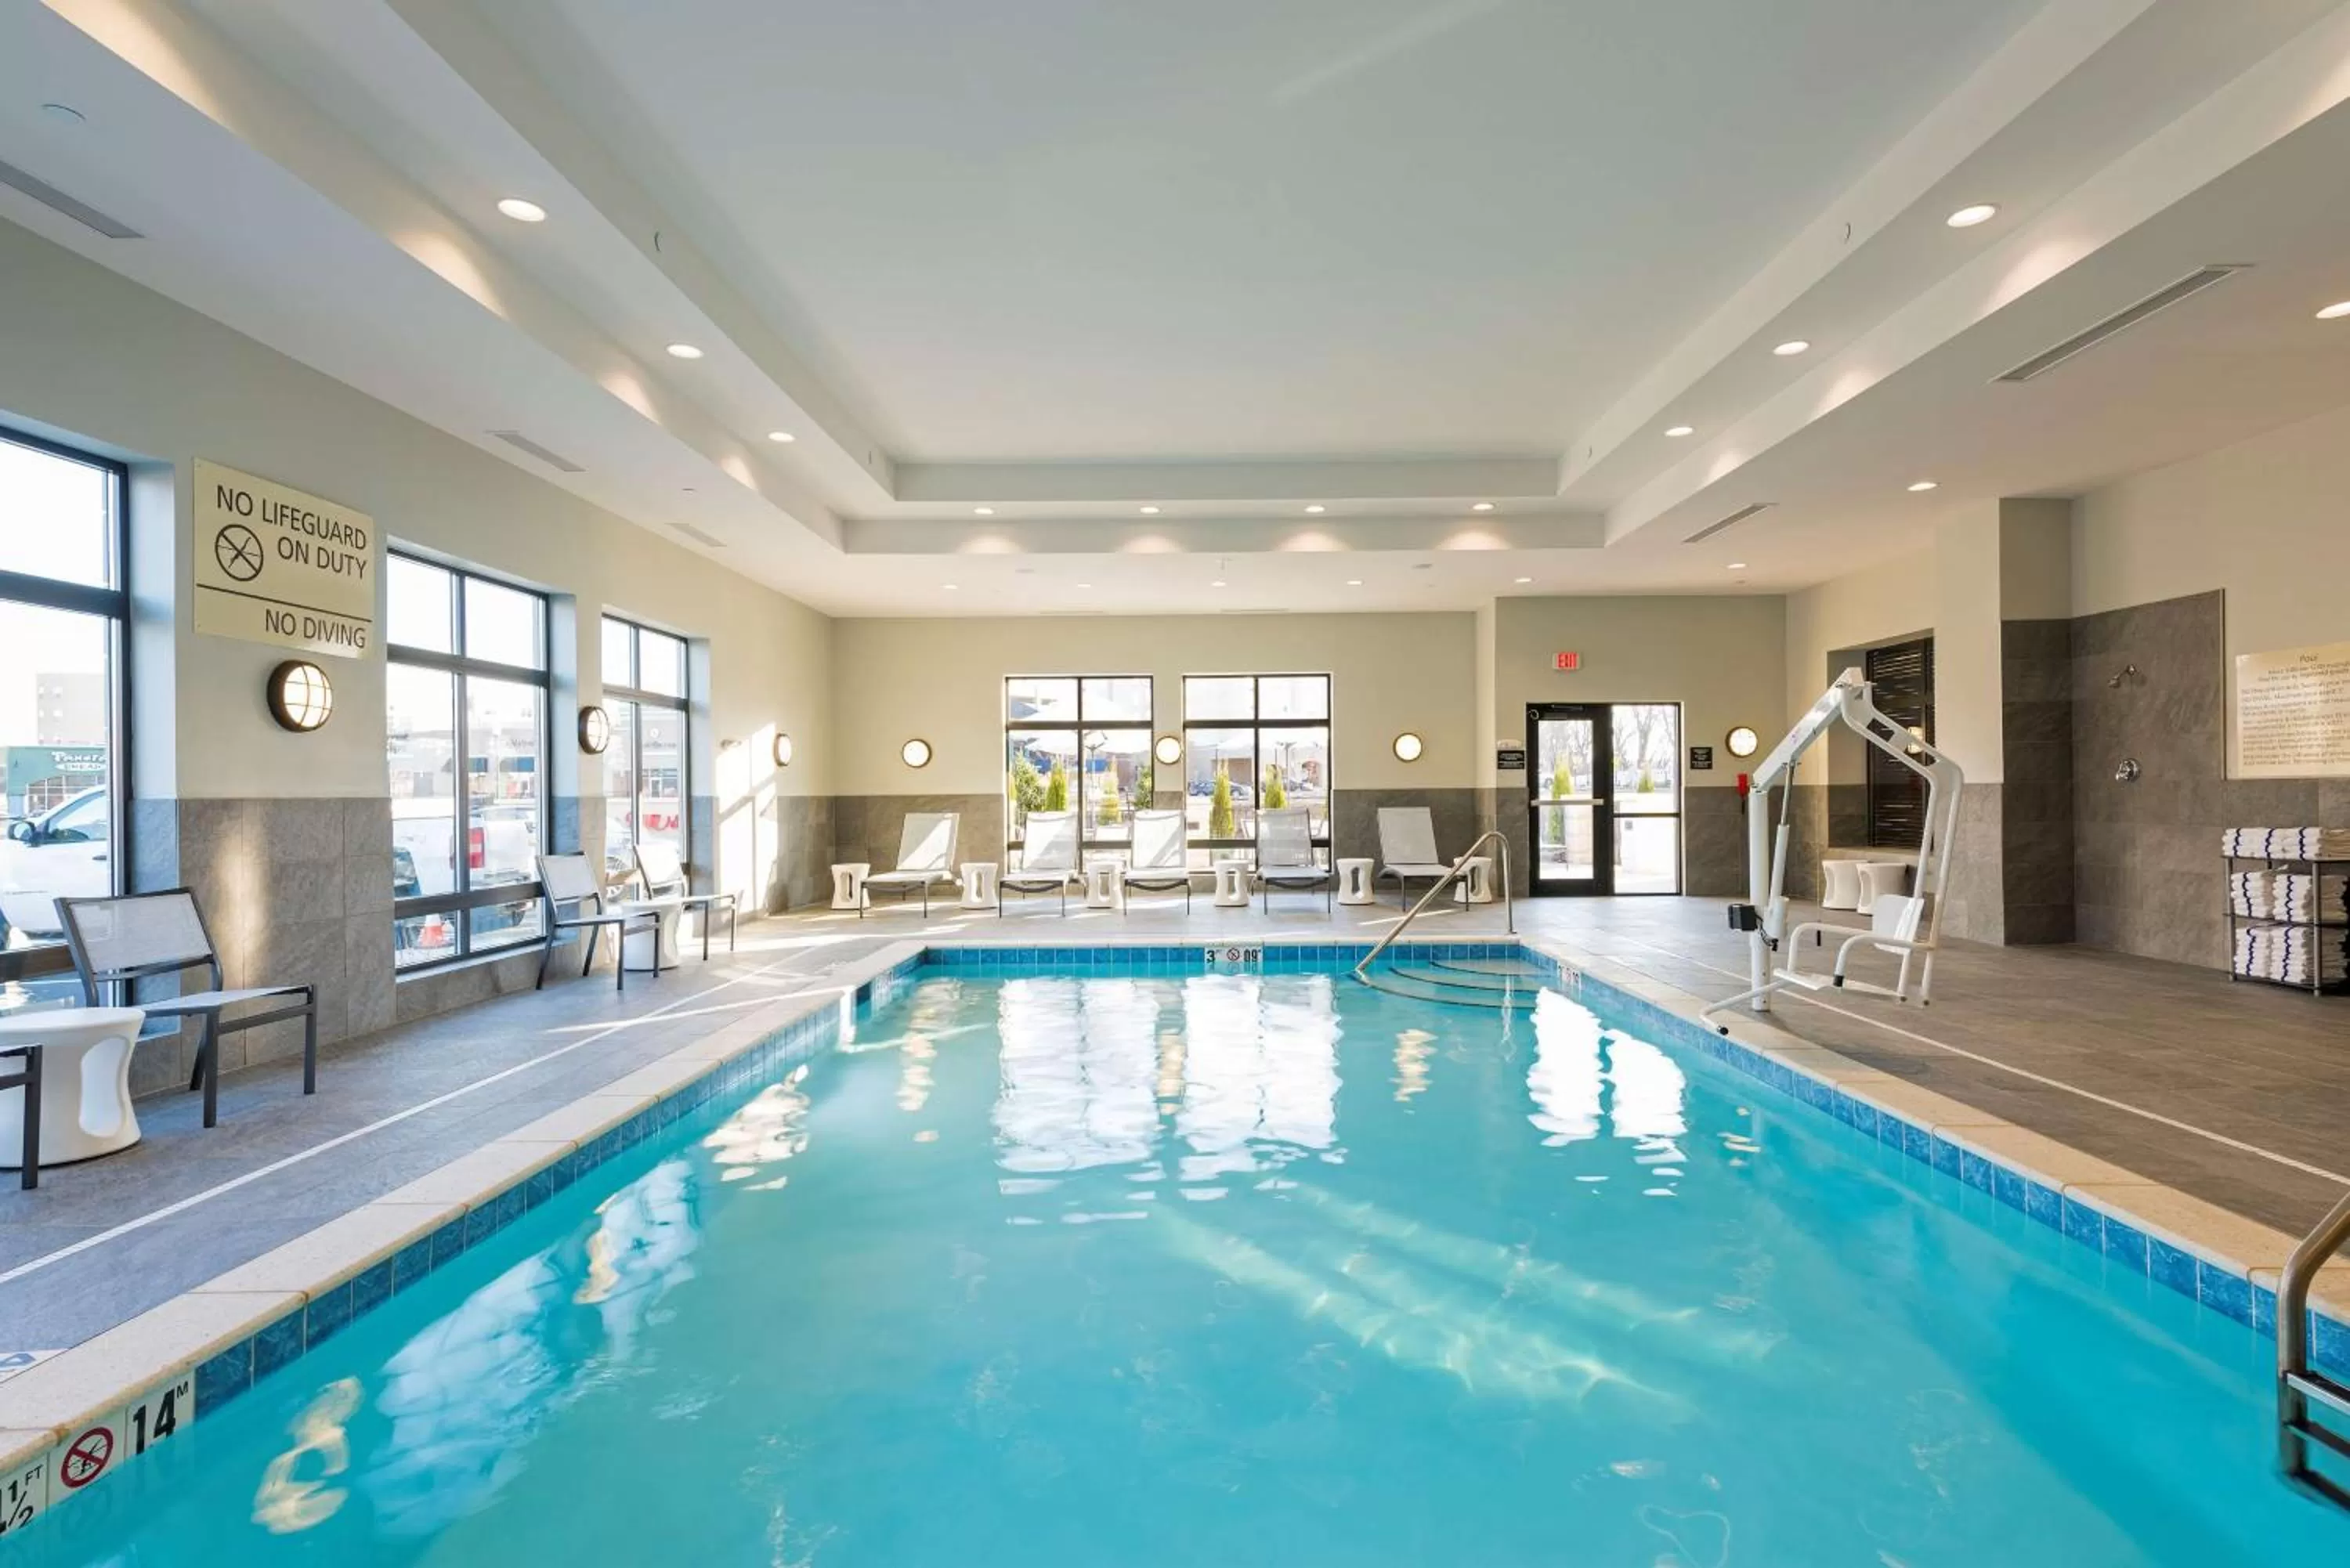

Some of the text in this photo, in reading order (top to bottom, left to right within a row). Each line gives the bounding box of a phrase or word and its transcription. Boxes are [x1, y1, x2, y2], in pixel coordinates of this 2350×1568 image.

[217, 485, 367, 550] NO LIFEGUARD
[277, 536, 367, 580] ON DUTY
[266, 609, 366, 649] NO DIVING
[1558, 653, 1577, 667] EXIT
[1206, 949, 1216, 963] 3
